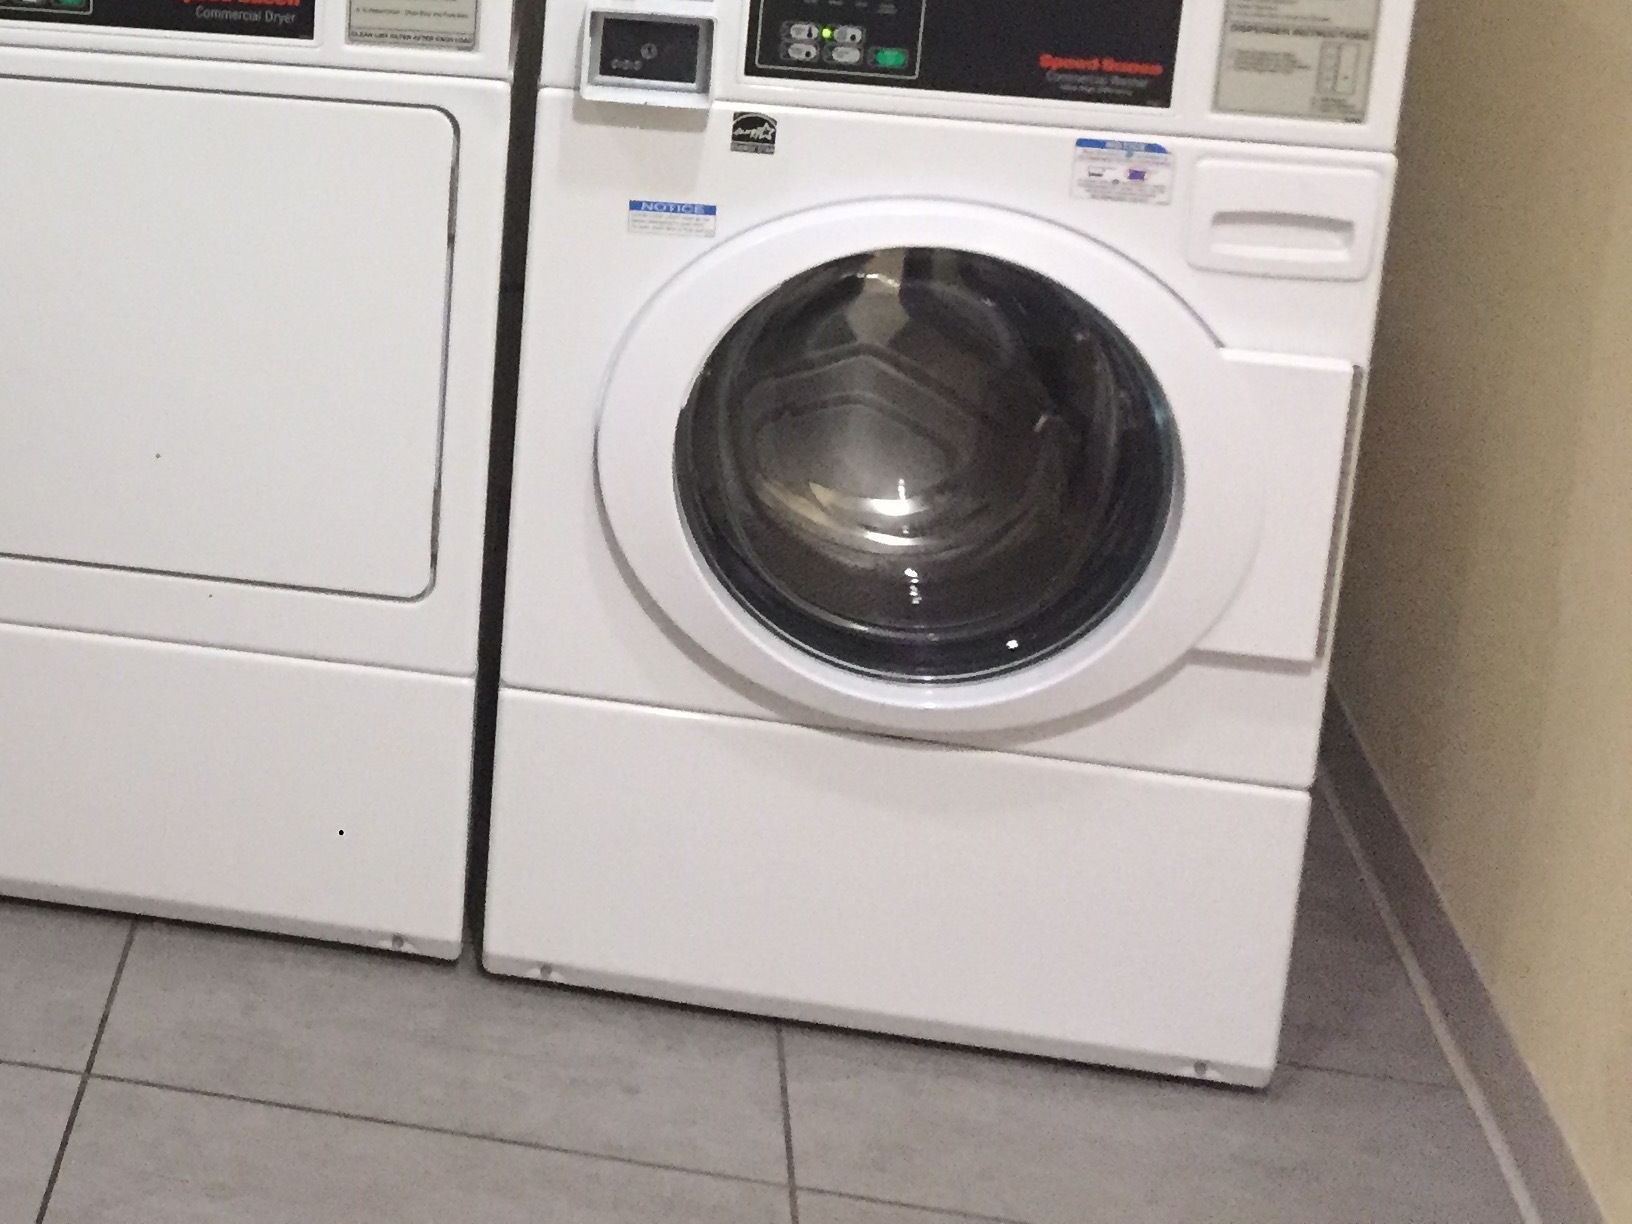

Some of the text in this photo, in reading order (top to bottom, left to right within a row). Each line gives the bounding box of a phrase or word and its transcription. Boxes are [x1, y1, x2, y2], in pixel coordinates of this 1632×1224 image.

[196, 5, 296, 24] Commercial Dryer
[640, 202, 705, 214] NOTICE
